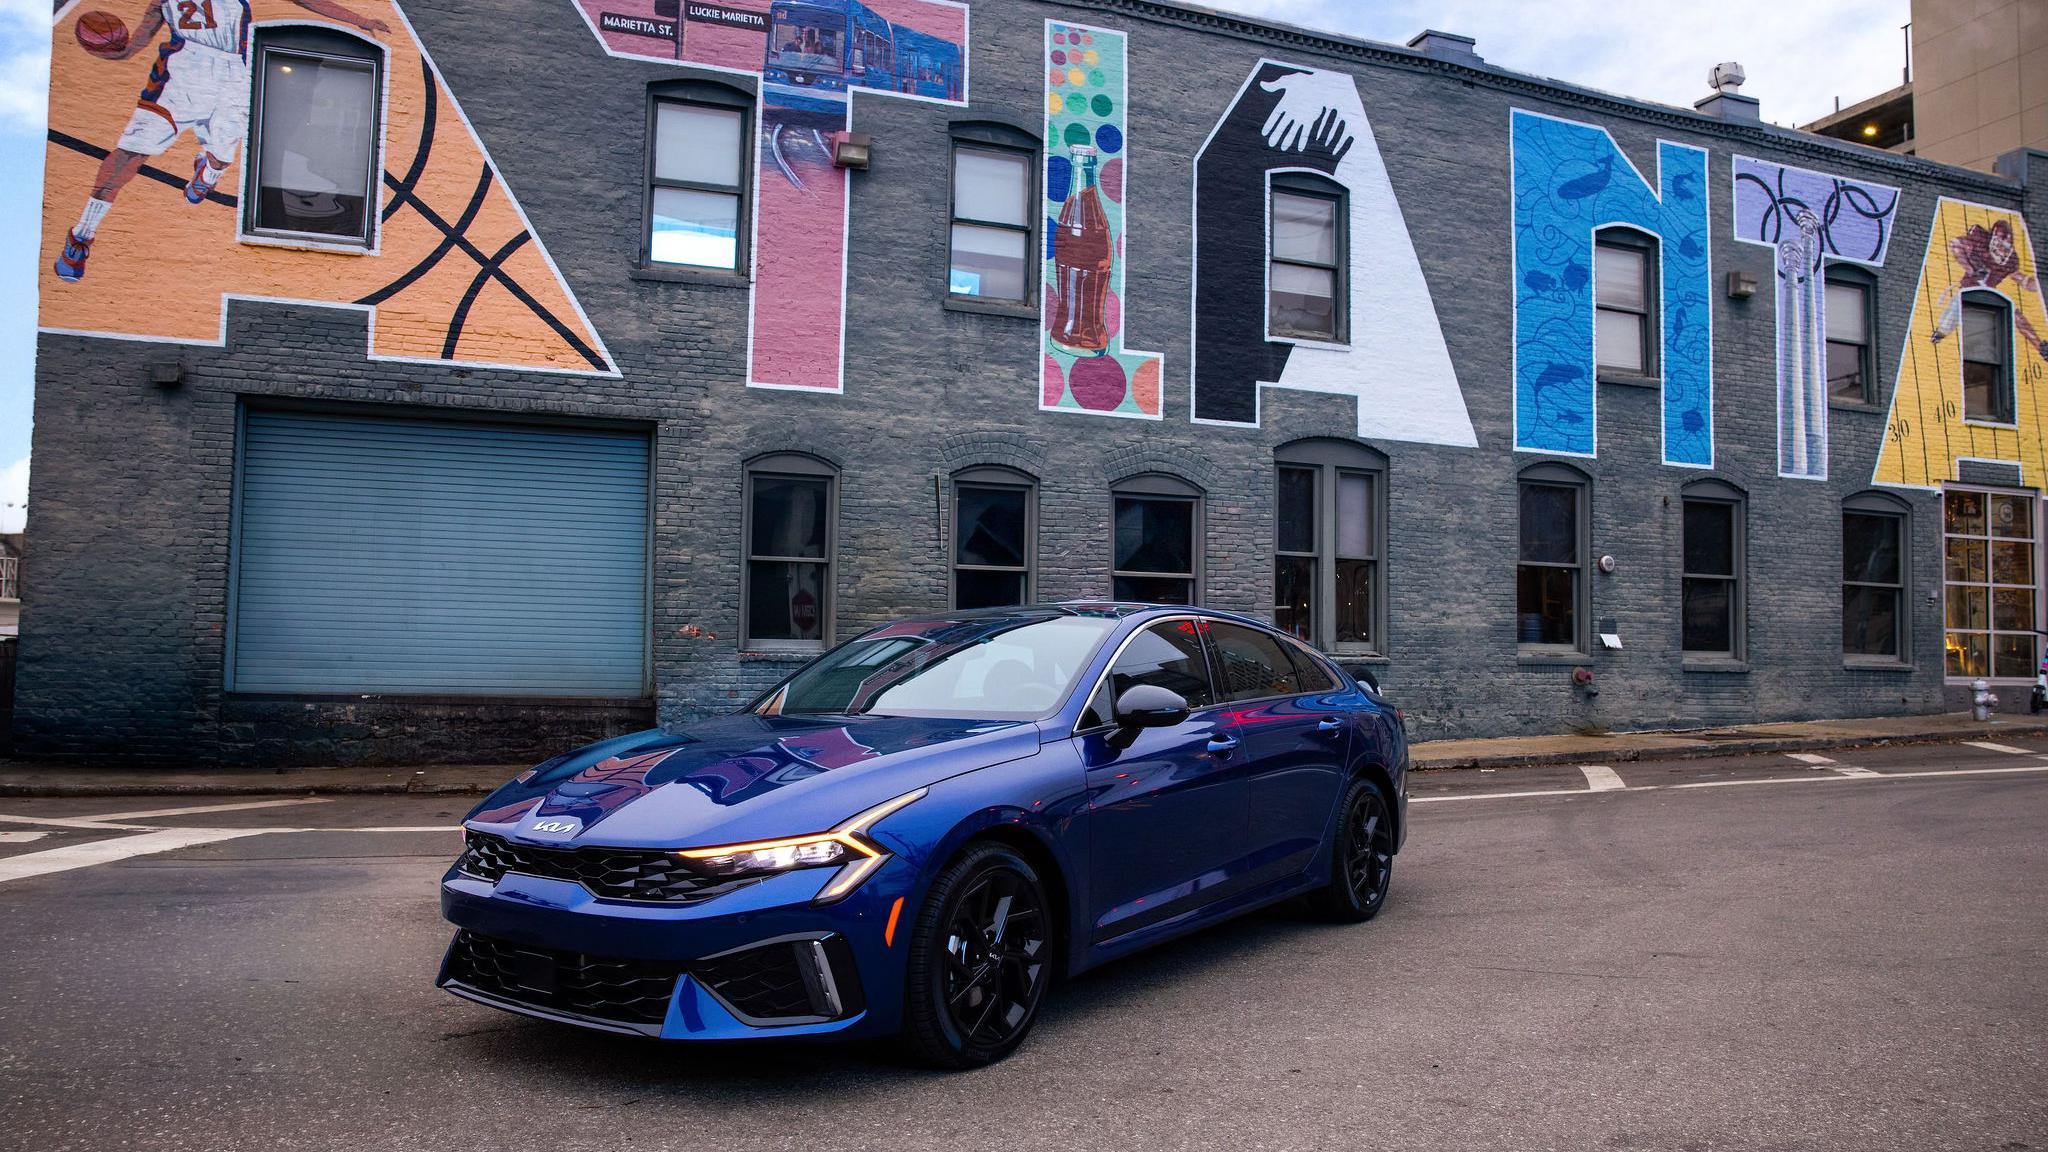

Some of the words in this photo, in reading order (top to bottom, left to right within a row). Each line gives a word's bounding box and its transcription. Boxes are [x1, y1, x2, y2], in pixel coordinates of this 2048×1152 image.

[177, 0, 217, 29] 21
[690, 6, 720, 19] LUCKIE
[722, 11, 764, 25] MARIETTA
[604, 16, 656, 33] MARIETTA
[659, 25, 673, 36] ST.
